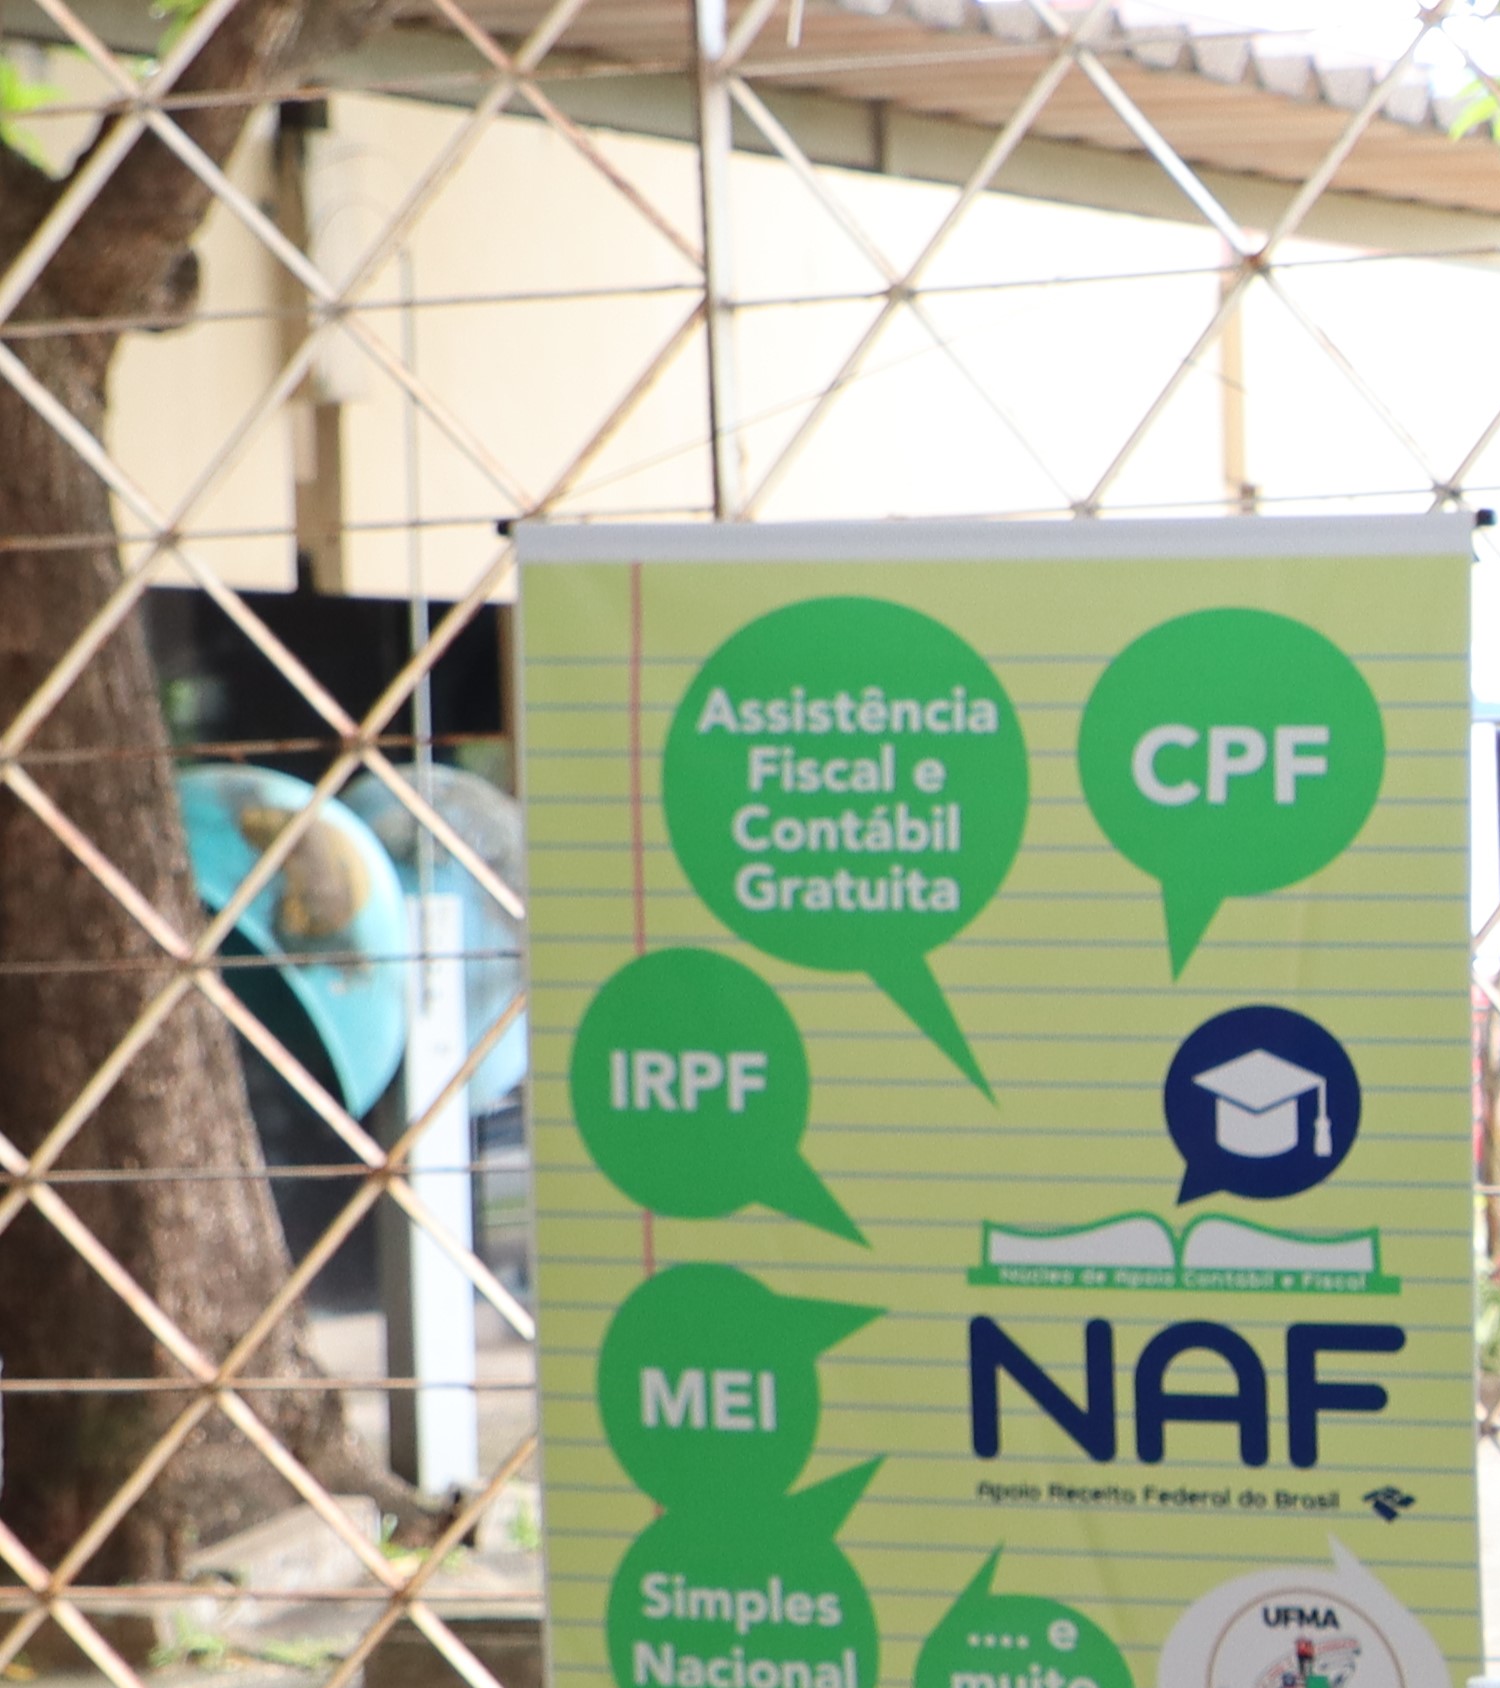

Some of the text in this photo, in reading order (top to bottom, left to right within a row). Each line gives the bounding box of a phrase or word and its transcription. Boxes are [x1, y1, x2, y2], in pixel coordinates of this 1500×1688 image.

[696, 685, 999, 734] Assistência
[747, 744, 947, 793] Fiscal e
[1131, 722, 1331, 807] CPF
[731, 802, 962, 853] Contábil
[734, 862, 961, 912] Gratuita
[609, 1048, 769, 1113] IRPF
[1000, 1267, 1367, 1291] Núcleo de Apoio Contábil e Fiscal
[640, 1368, 777, 1431] MEI
[970, 1315, 1406, 1468] NAF
[977, 1480, 1340, 1511] Apoio Receita Federal do Brasil
[640, 1572, 842, 1634] Simples
[1262, 1606, 1340, 1630] UFMA
[1047, 1619, 1079, 1650] e
